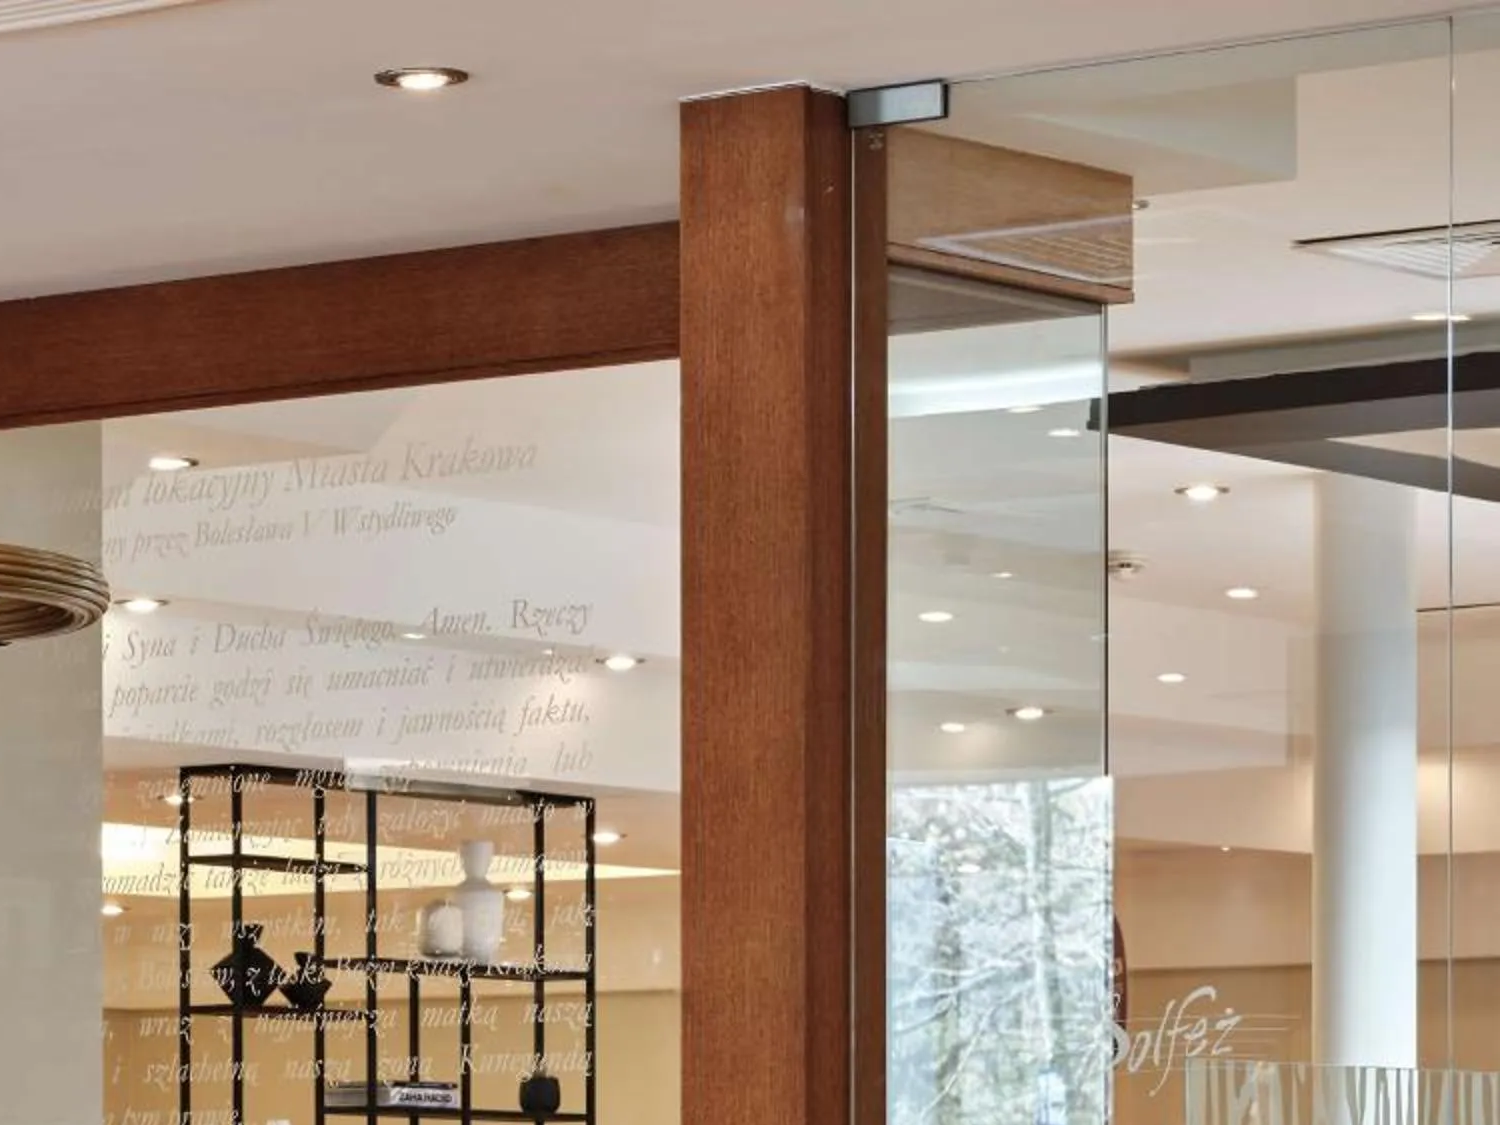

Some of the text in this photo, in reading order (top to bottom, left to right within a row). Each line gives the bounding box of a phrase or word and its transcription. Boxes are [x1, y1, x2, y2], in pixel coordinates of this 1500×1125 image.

[284, 456, 388, 491] Miasta
[400, 436, 538, 481] Krakowa
[123, 629, 176, 670] Syna
[190, 627, 201, 656] i
[214, 618, 286, 653] Ducha
[422, 607, 492, 636] Amen.
[511, 599, 593, 637] Rzeczy
[109, 674, 200, 718] poparcie
[209, 665, 273, 710] godzi
[285, 664, 313, 698] się
[512, 694, 590, 737] faktu,
[551, 741, 593, 772] lub
[421, 992, 500, 1031] matką
[520, 1001, 594, 1032] naszą
